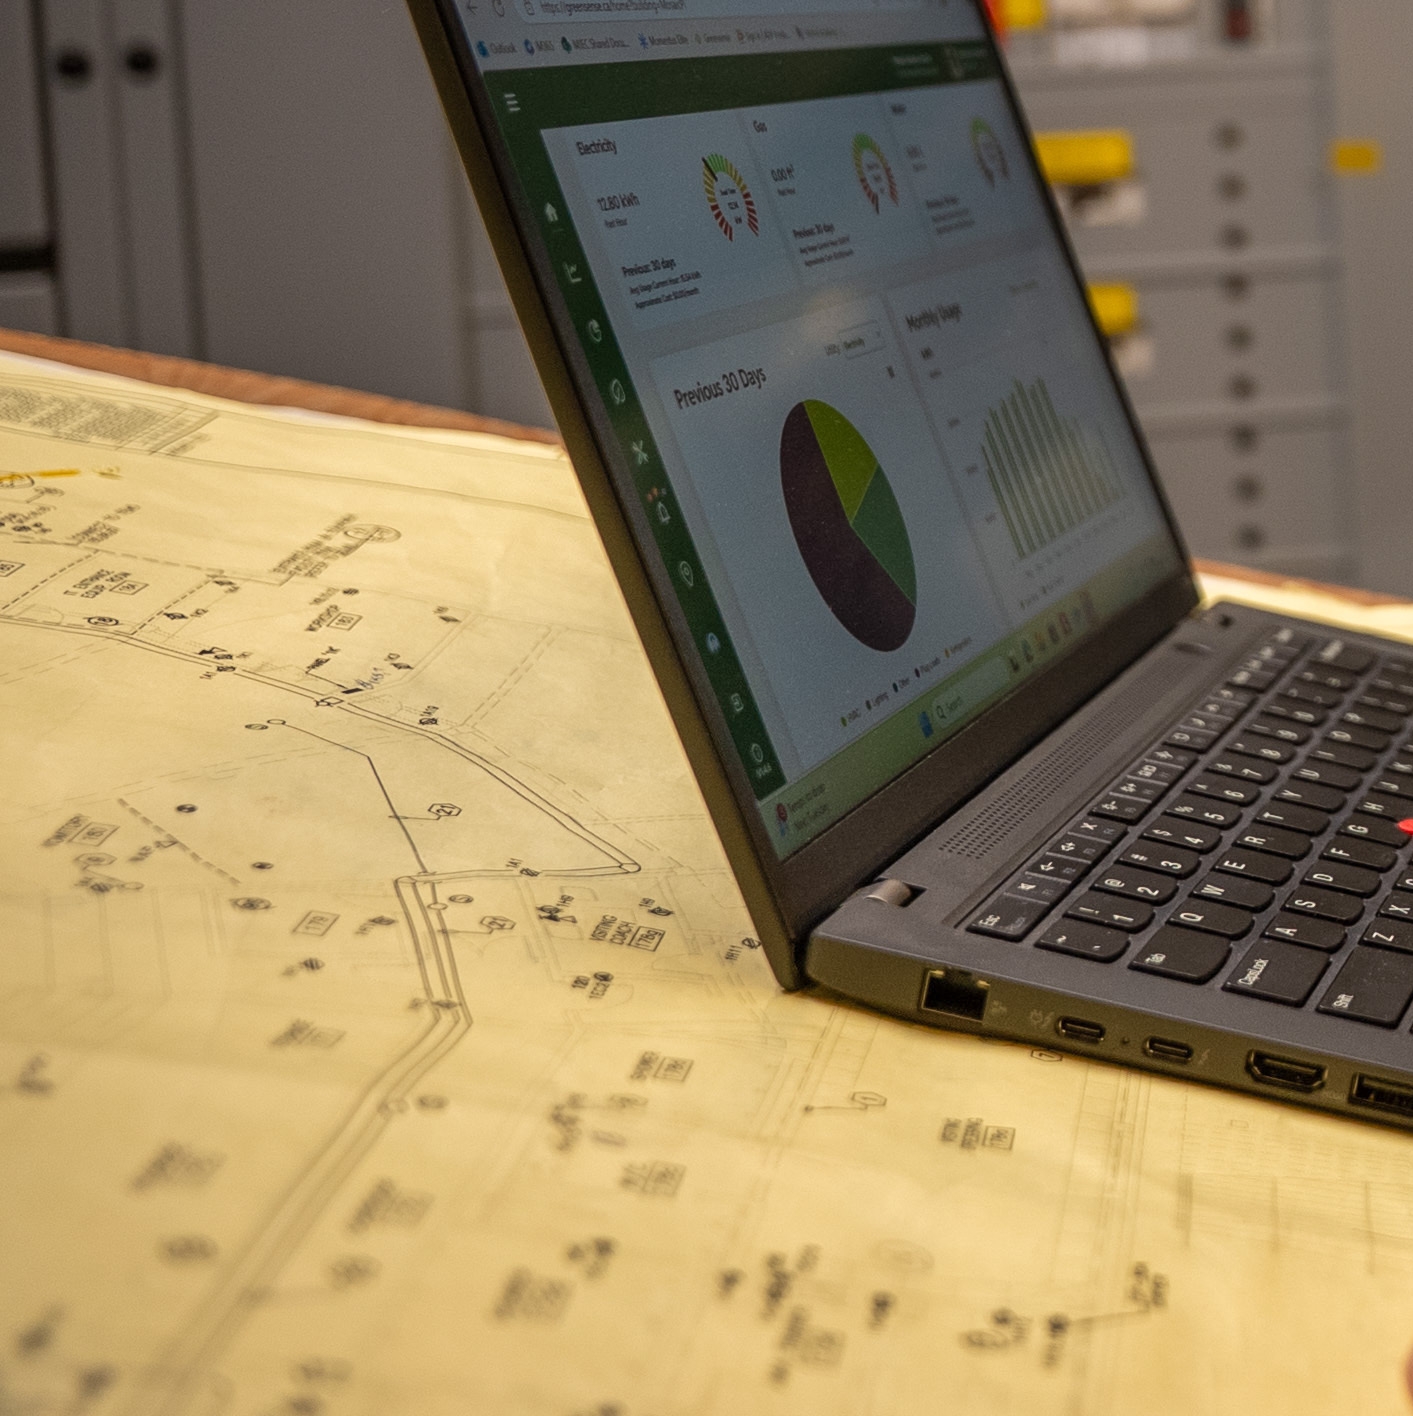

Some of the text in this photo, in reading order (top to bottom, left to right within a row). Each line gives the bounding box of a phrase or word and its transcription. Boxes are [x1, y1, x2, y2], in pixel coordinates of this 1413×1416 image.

[576, 138, 617, 156] Electricity
[673, 366, 767, 410] Previous 30 Days
[1224, 789, 1245, 799] 6
[1204, 811, 1225, 822] 5
[1262, 811, 1284, 821] T
[1348, 823, 1369, 834] G
[1184, 835, 1203, 845] 4
[1243, 834, 1266, 845] R
[1330, 846, 1350, 858] F
[1160, 859, 1181, 871] 3
[1223, 860, 1246, 871] E
[1313, 872, 1334, 882] D
[1137, 886, 1159, 897] 2
[1200, 884, 1225, 897] W
[1294, 898, 1316, 910] S
[1388, 903, 1411, 915] X
[979, 915, 1000, 928] Esc
[1179, 911, 1204, 922] Q
[1275, 925, 1297, 937] A
[1372, 931, 1395, 942] Z
[1237, 958, 1269, 986] CapsLock
